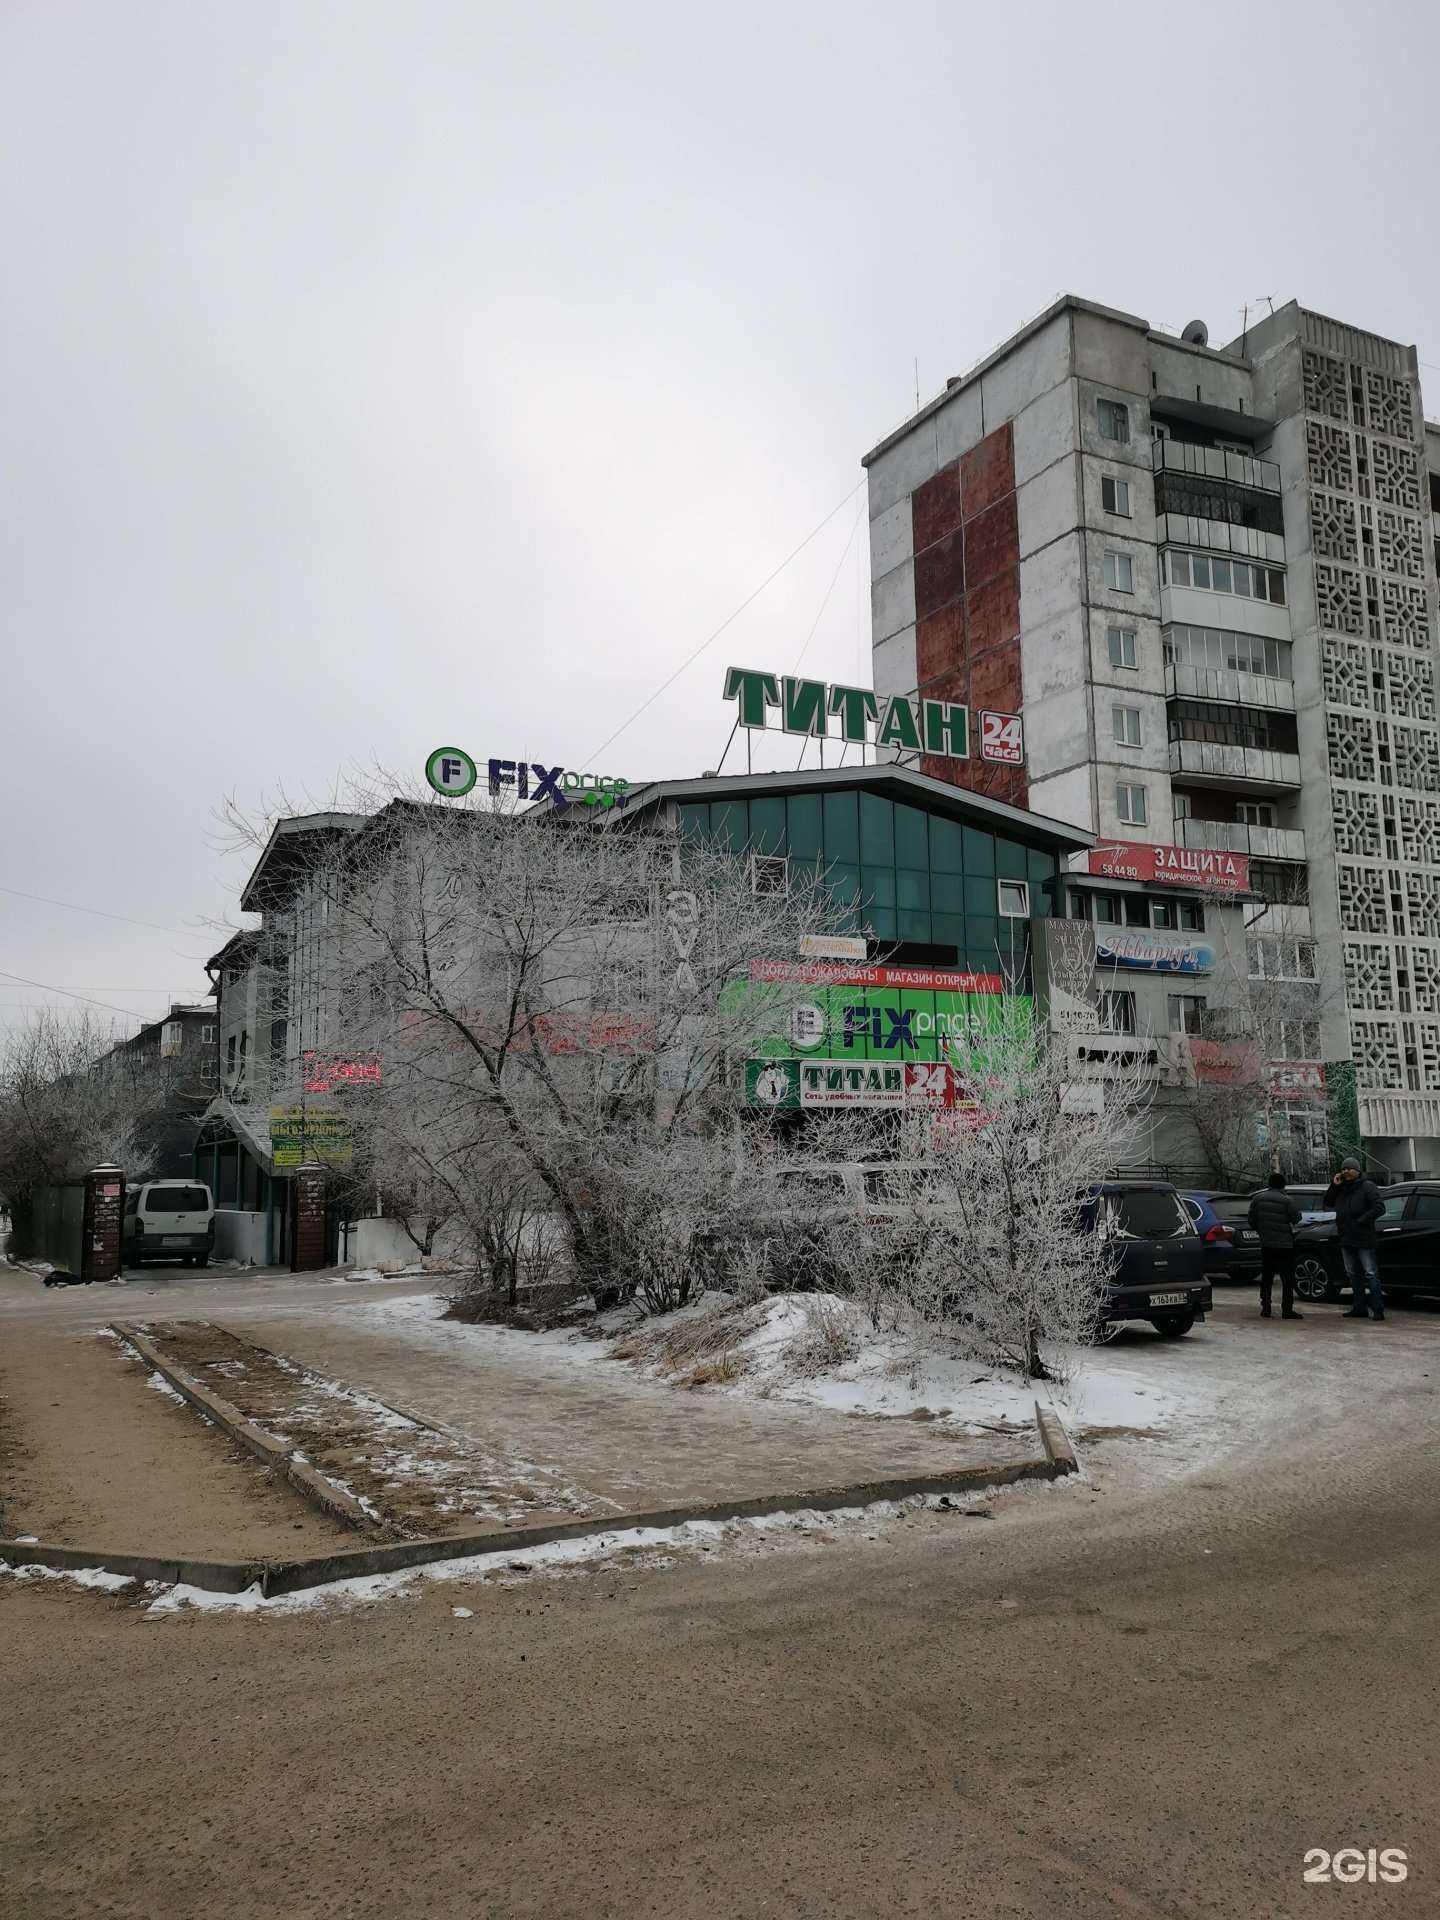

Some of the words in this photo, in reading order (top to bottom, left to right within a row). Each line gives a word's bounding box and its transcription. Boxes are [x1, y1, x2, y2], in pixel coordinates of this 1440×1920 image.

[723, 666, 970, 759] ТИТАН
[984, 716, 1022, 748] 24
[985, 744, 1021, 760] часа
[441, 758, 461, 784] F
[488, 758, 571, 812] FIX
[563, 771, 630, 794] price
[1154, 848, 1237, 875] ЗАЩИТА
[1155, 870, 1202, 883] юридическое
[886, 971, 932, 984] МАГАЗИН
[843, 1006, 919, 1049] FIX
[803, 1065, 903, 1092] ТИТАН
[911, 1065, 948, 1095] 24
